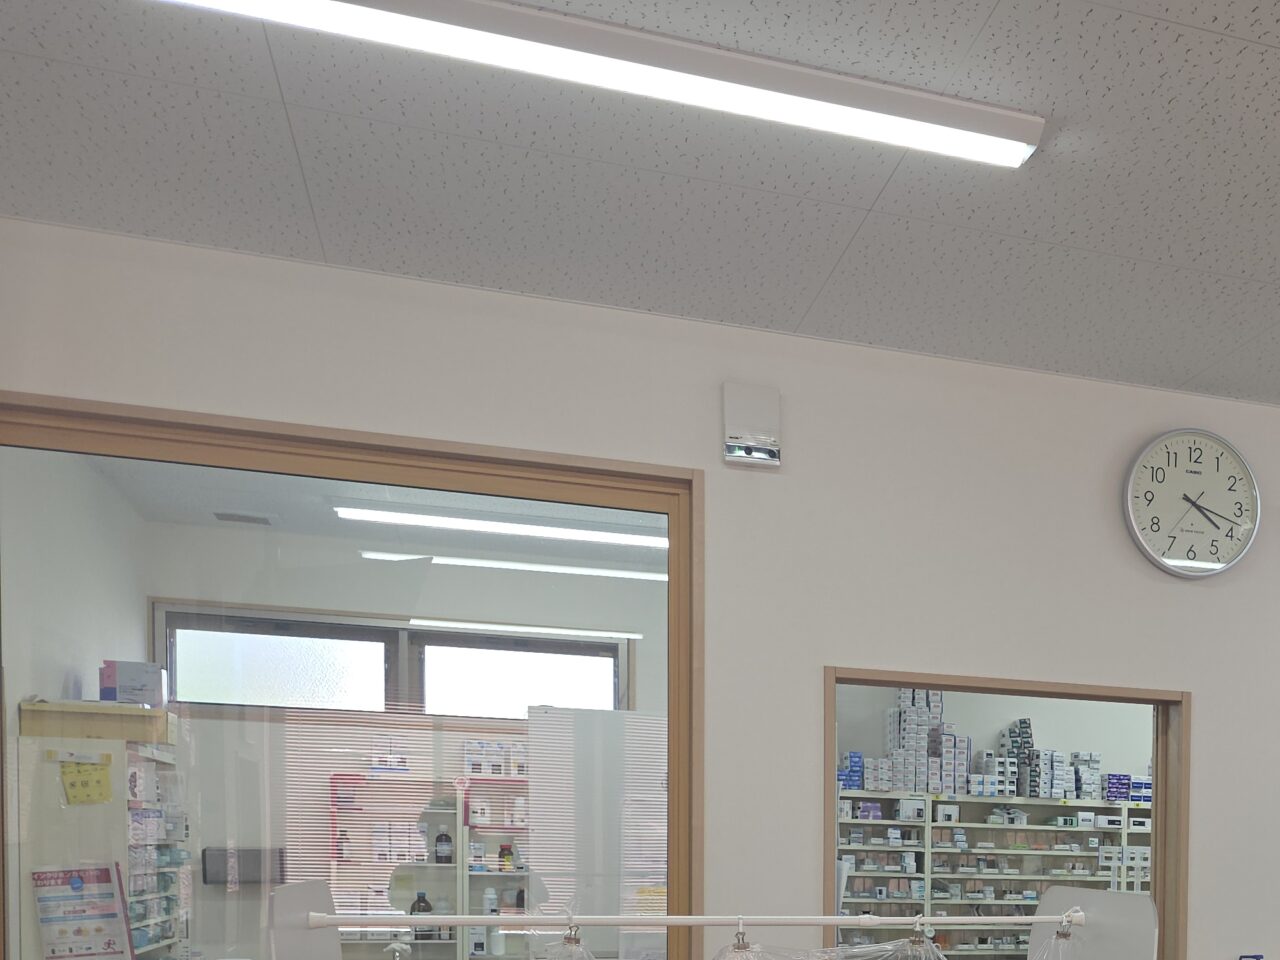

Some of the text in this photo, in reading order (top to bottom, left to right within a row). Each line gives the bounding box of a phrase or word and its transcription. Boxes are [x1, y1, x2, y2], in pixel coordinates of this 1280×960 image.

[1166, 451, 1178, 468] 11
[1188, 446, 1203, 464] 12
[1215, 456, 1220, 473] 1
[1150, 466, 1166, 484] 10
[1227, 475, 1238, 492] 2
[1144, 490, 1155, 507] 9
[1233, 501, 1244, 518] 3
[1150, 516, 1161, 533] 8
[1225, 526, 1235, 541] 4
[1167, 535, 1177, 551] 7
[1209, 539, 1219, 556] 5
[1186, 544, 1197, 561] 6
